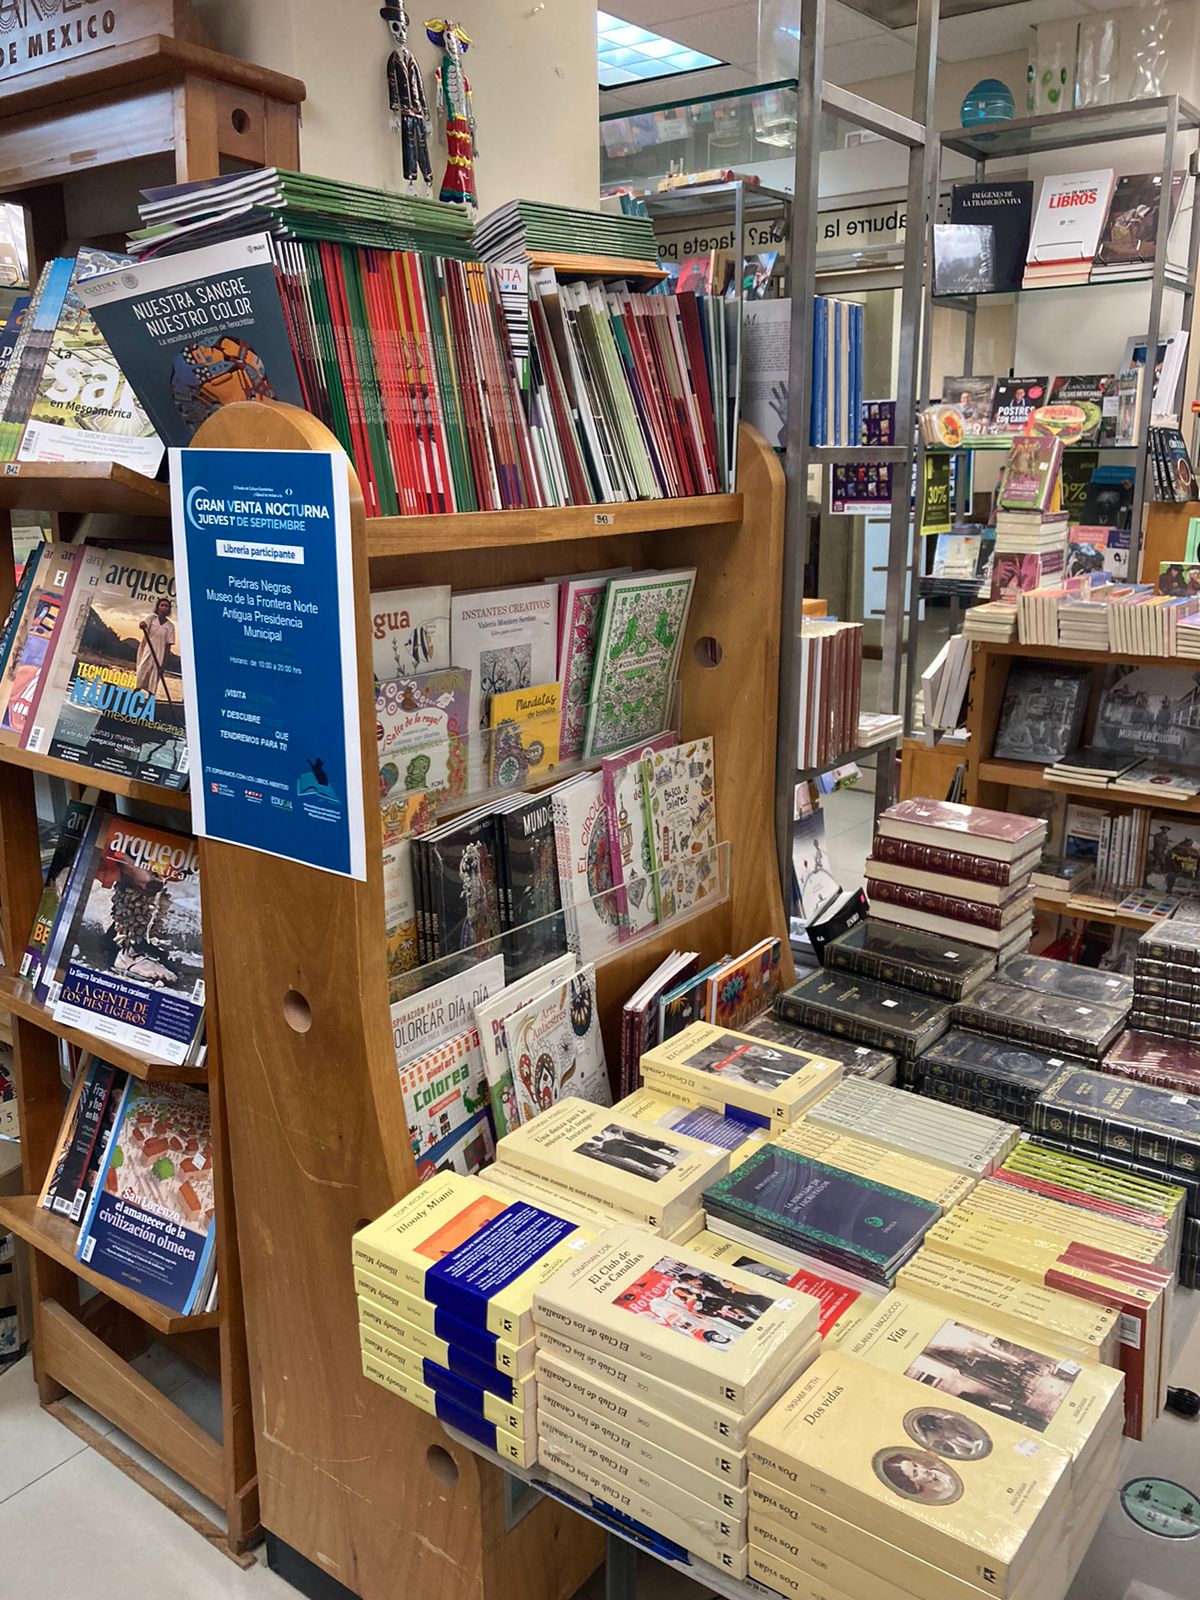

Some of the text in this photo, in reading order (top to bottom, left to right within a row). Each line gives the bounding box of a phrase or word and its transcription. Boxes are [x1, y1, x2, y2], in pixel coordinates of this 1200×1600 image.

[28, 9, 116, 59] MEXICO
[963, 199, 971, 207] LA
[1048, 192, 1098, 209] LIBROS
[83, 281, 118, 294] CULTURA
[132, 277, 252, 321] NUESTRA SANGRE,
[145, 297, 254, 338] NUESTRO COLOR
[167, 331, 192, 347] escultura
[56, 347, 73, 360] La
[50, 399, 133, 420] en Mesoamérica
[928, 484, 947, 505] 30%
[195, 498, 330, 519] GRAN VENTA NOCTURNA
[198, 514, 306, 532] JUEVES DE SEPTIEMBRE
[223, 544, 296, 560] Librería participante
[228, 575, 292, 596] Piedras Negras
[206, 588, 319, 615] Museo de la Frontera Norte
[461, 599, 551, 622] INSTANTES CREATIVOS
[222, 606, 304, 629] Antigua Presidencia
[243, 624, 283, 643] Municipal
[77, 661, 138, 689] TECNOLOGÍA
[70, 676, 156, 722] NÁUTICA
[515, 694, 557, 712] Mandalas
[101, 708, 186, 738] mesoamericana
[227, 709, 261, 724] DESCUBRE
[220, 729, 278, 750] TENDREMOS PARA
[275, 730, 289, 742] QUE
[663, 784, 690, 802] Busca y
[578, 856, 587, 875] EL
[69, 967, 76, 975] La
[76, 969, 89, 981] Sierra
[89, 972, 117, 990] Tarahumara
[61, 986, 147, 1026] LOS PIES LIGEROS
[75, 982, 150, 1016] LA GENTE DE
[427, 997, 443, 1014] PARA
[448, 994, 466, 1022] DÍA
[472, 983, 489, 1007] DÍA
[541, 1003, 557, 1021] Arte
[426, 1056, 456, 1082] pixel art
[413, 1063, 470, 1113] Colorea
[534, 1108, 588, 1144] Una danza para la
[565, 1124, 576, 1135] del
[566, 1123, 593, 1142] Invierno
[123, 1187, 181, 1221] San Lorenzo
[392, 1203, 408, 1219] TOM
[396, 1187, 456, 1235] Bloody Miami
[115, 1201, 186, 1240] el amanecer de la
[99, 1208, 156, 1245] civilización
[156, 1235, 196, 1262] olmeca
[355, 1250, 398, 1277] Bloody Miami
[587, 1248, 631, 1286] El Club de
[594, 1252, 645, 1294] los Canallas
[664, 1261, 688, 1279] Club
[538, 1304, 630, 1352] El Club de los Canallas
[874, 1301, 902, 1332] MAZZUCCO
[887, 1327, 908, 1345] Vita
[365, 1363, 408, 1393] Bloody Miami
[784, 1376, 822, 1413] VIKRAM SETH
[803, 1383, 845, 1426] Dos vidas
[543, 1448, 631, 1506] El Club de los Canallas
[752, 1451, 798, 1482] Dos vidas
[753, 1489, 799, 1521] Dos vidas
